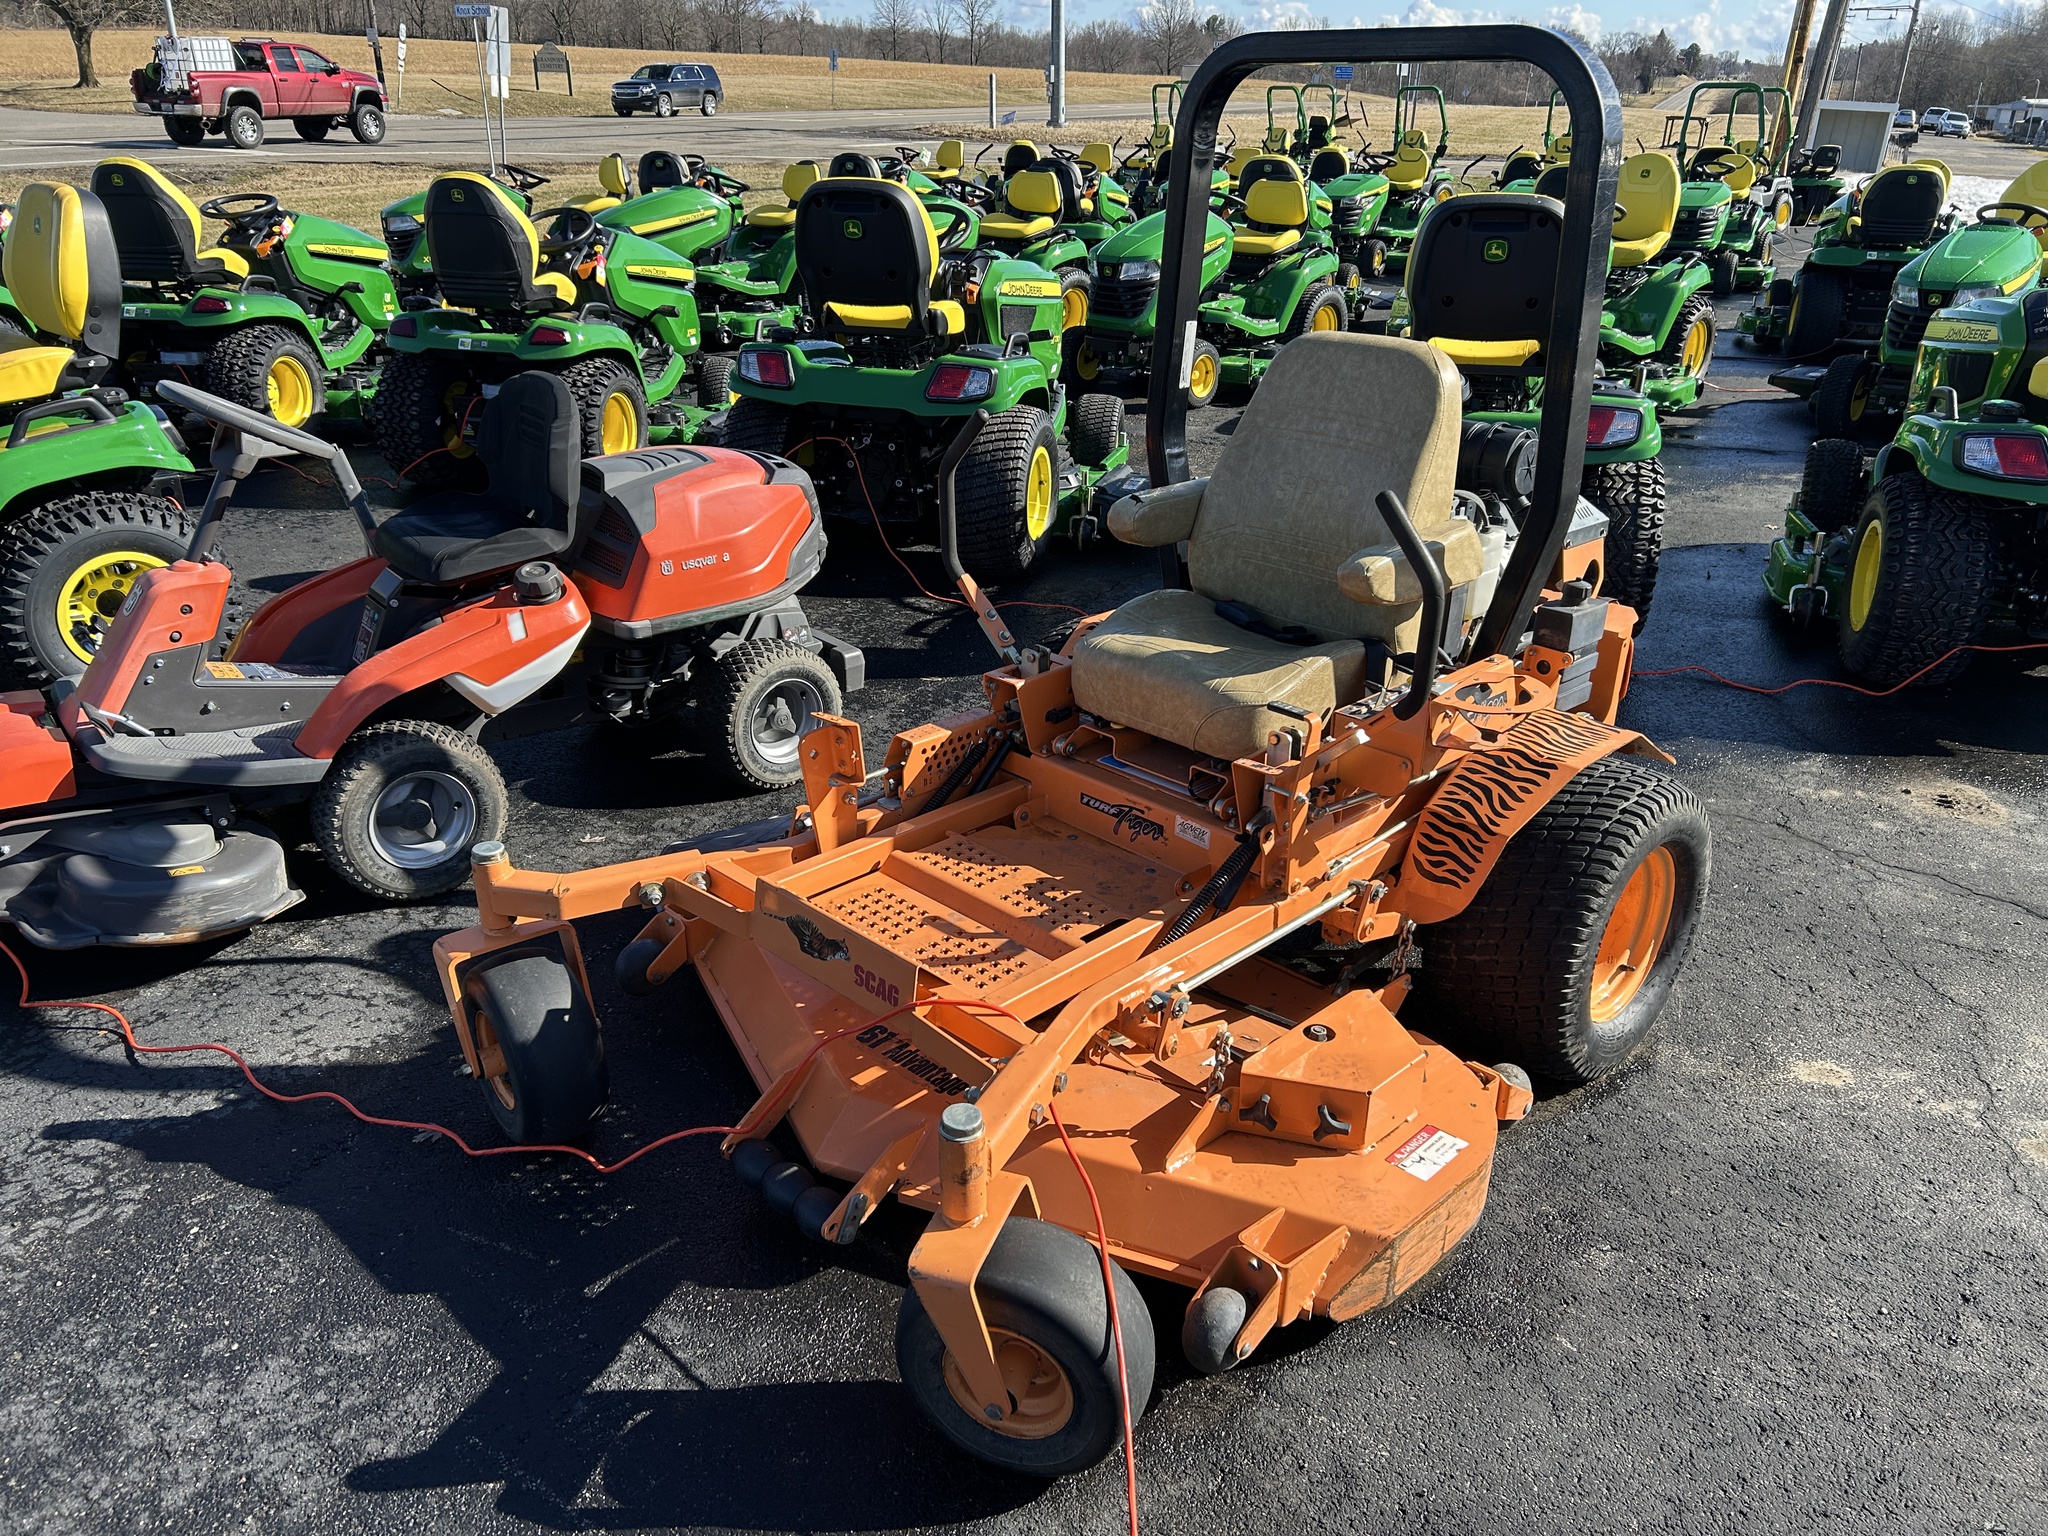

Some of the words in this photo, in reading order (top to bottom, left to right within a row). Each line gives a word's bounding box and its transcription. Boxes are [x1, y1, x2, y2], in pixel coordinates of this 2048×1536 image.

[456, 5, 470, 15] Knox
[471, 5, 490, 15] School
[641, 267, 653, 275] JOHN
[653, 267, 667, 276] DEERE
[1008, 283, 1025, 294] JOHN
[1025, 283, 1043, 296] DEERE
[1944, 326, 1963, 340] JOHN
[1963, 326, 1992, 341] DEERE
[1080, 795, 1121, 816] TURF
[1110, 802, 1161, 843] Tiger
[1177, 820, 1208, 838] AGNEW
[854, 963, 900, 1008] SCAG
[881, 1042, 970, 1097] Advantage
